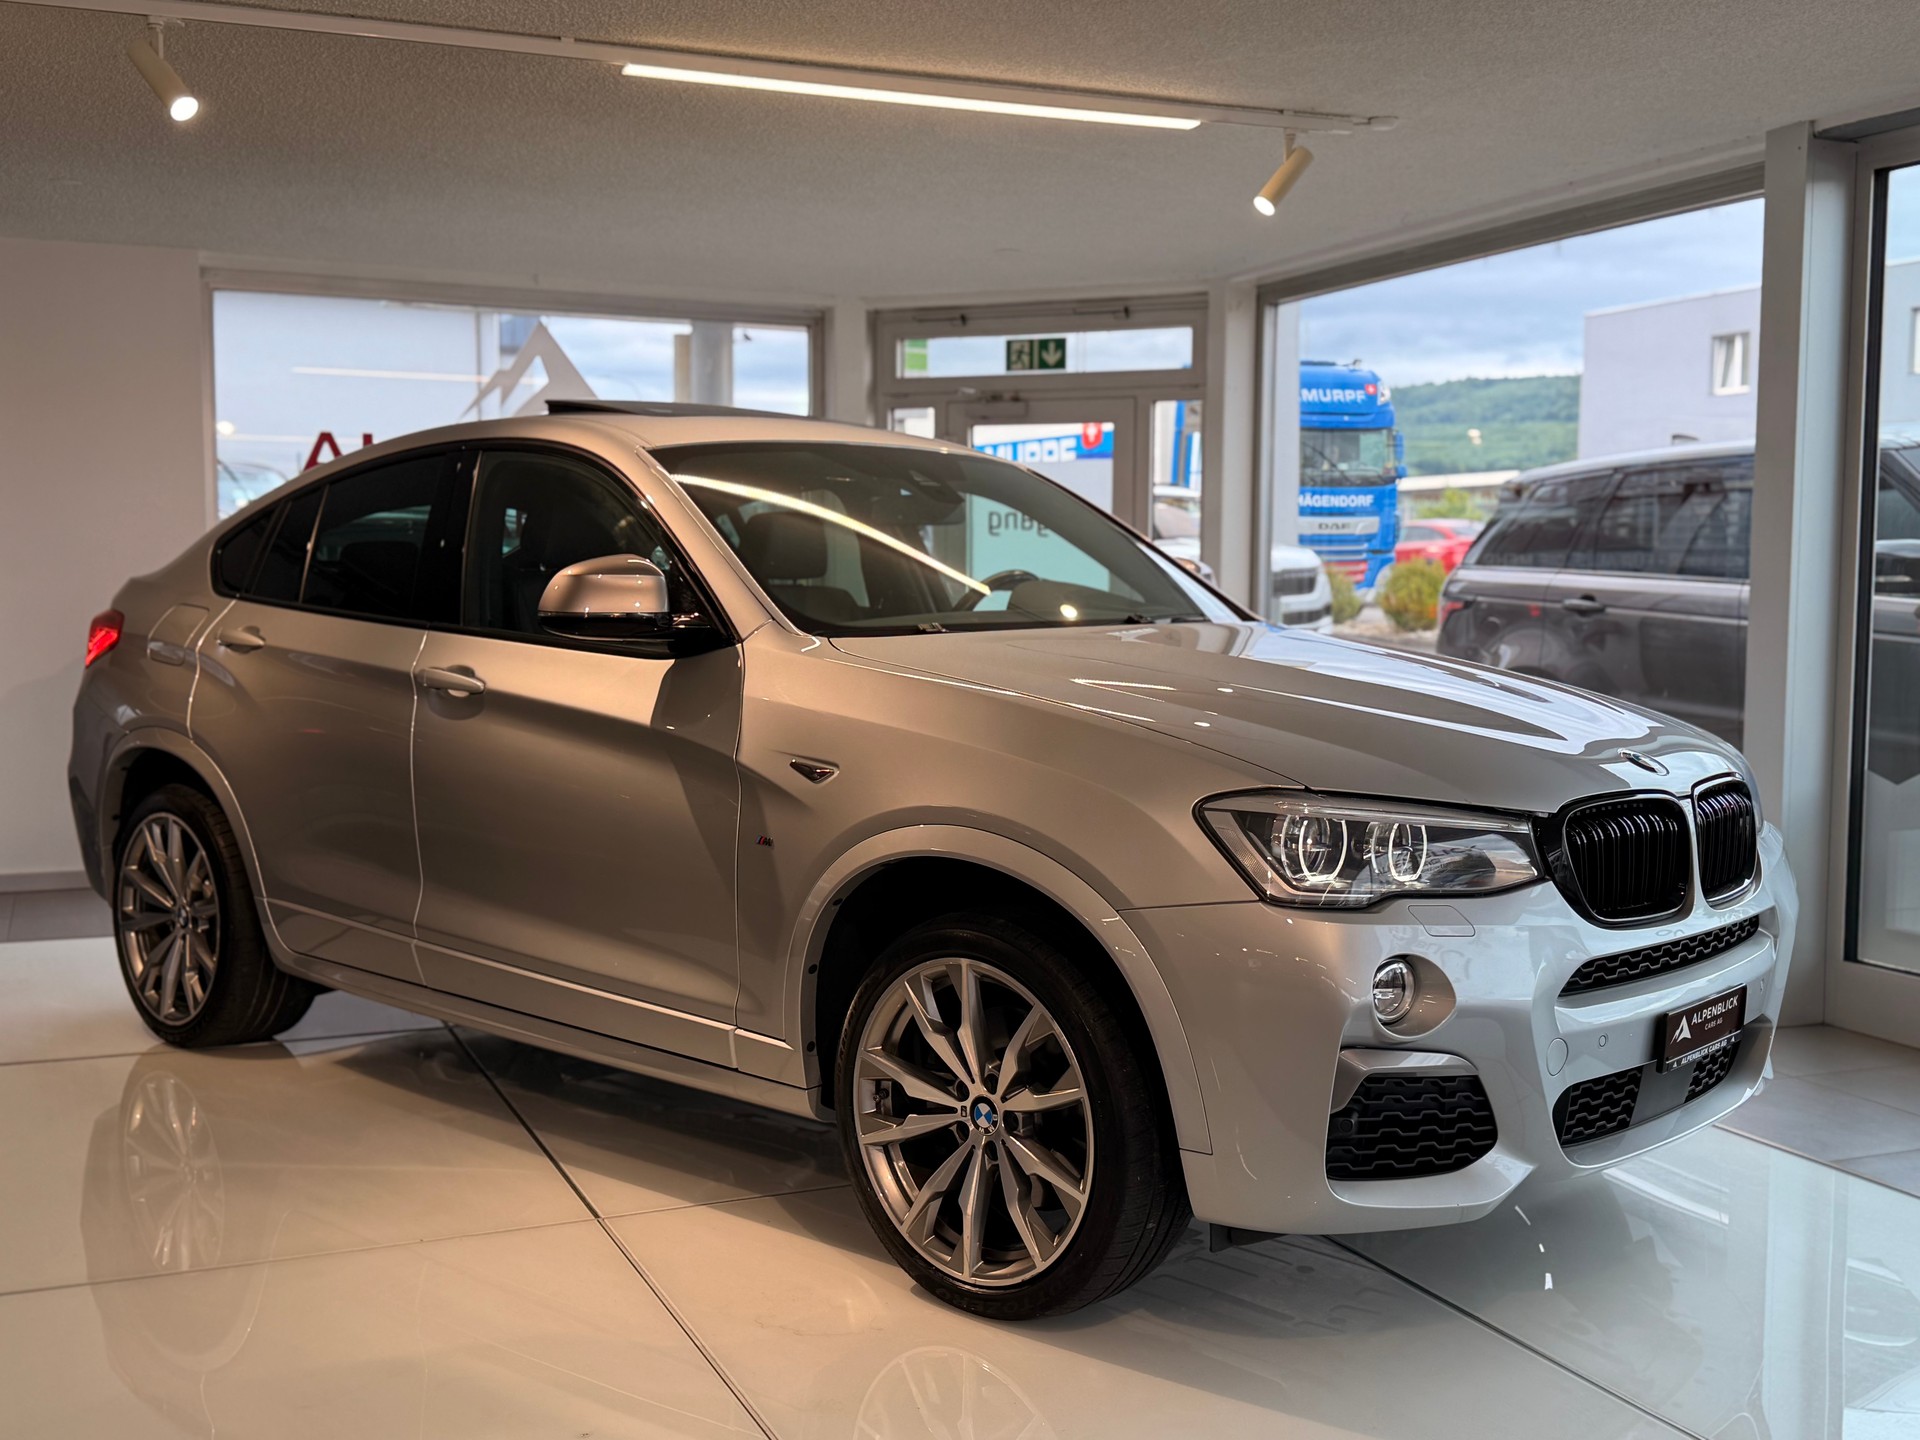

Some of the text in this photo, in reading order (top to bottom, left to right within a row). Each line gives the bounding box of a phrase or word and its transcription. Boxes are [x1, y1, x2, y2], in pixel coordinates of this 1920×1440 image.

[1300, 388, 1367, 404] MURPF
[1318, 523, 1350, 531] DAF
[1691, 995, 1739, 1026] ALPENBLICK
[1704, 1021, 1717, 1031] CARS
[1681, 1039, 1728, 1065] ALPENBLICK CARS AG
